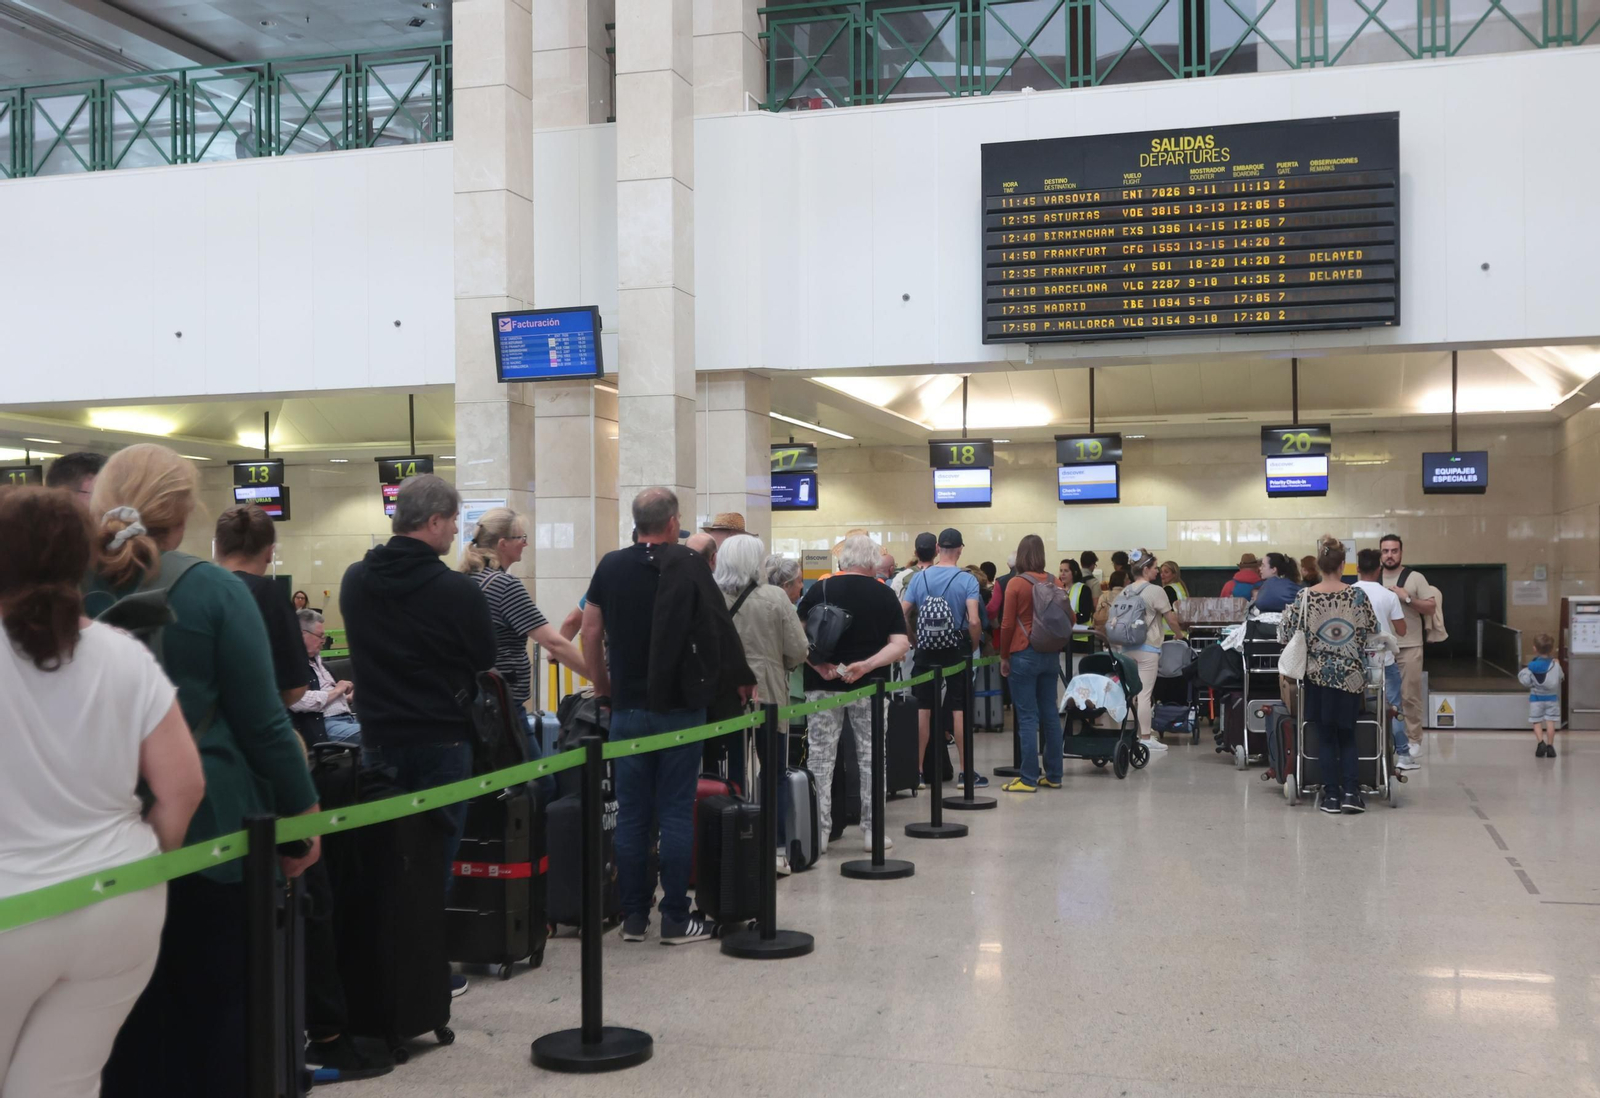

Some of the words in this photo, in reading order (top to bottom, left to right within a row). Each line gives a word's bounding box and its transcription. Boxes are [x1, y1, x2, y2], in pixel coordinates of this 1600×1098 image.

[1151, 135, 1215, 153] SALIDAS
[1139, 148, 1231, 167] DEPARTURES
[1276, 161, 1299, 169] PUERTA
[1309, 157, 1359, 167] OBSERVACIONES
[1123, 172, 1142, 180] VUELO
[1189, 166, 1226, 175] MOSTRADOR
[1232, 163, 1265, 172] EMBARQUE
[1232, 170, 1260, 178] BOARDING
[1309, 165, 1336, 173] REMARKS
[1044, 177, 1068, 186] DESTINO
[1122, 178, 1141, 186] FLIGHT
[1189, 173, 1215, 181] COUNTER
[1002, 197, 1036, 207] 11:45
[1044, 193, 1100, 204] VARSOVIA
[1123, 190, 1142, 200] ENT
[1152, 187, 1180, 198] 7026
[1189, 186, 1215, 196] 9-11
[1233, 181, 1270, 193] 11:13
[1278, 180, 1286, 190] 2
[1044, 182, 1077, 191] DESTINATION
[1002, 215, 1036, 225] 12:35
[1044, 211, 1099, 222] ASTURIAS
[1123, 208, 1143, 218] VOE
[1152, 206, 1180, 216] 3815
[1188, 203, 1224, 214] 13-13
[1233, 200, 1270, 211] 12:05
[1278, 199, 1286, 208] 5
[1002, 233, 1036, 243] 12:40
[1044, 229, 1114, 241] BIRMINGHAM
[1123, 226, 1143, 236] EXS
[1152, 224, 1180, 235] 1396
[1189, 221, 1224, 233] 14-15
[1233, 218, 1269, 230] 12:05
[1278, 217, 1286, 227] 7
[1002, 251, 1036, 261] 14:50
[1044, 247, 1106, 258] FRANKFURT
[1123, 245, 1143, 255] CFG
[1152, 243, 1180, 253] 1553
[1189, 240, 1224, 251] 13-15
[1233, 237, 1269, 248] 14:20
[1278, 237, 1286, 246] 2
[1002, 269, 1036, 279] 12:35
[1044, 265, 1106, 276] FRANKFURT
[1123, 263, 1135, 272] 4Y
[1152, 262, 1171, 271] 501
[1189, 258, 1224, 269] 18-20
[1234, 256, 1270, 267] 14:20
[1278, 255, 1286, 265] 2
[1310, 250, 1362, 263] DELAYED
[1002, 287, 1036, 296] 14:10
[1045, 283, 1107, 295] BARCELONA
[1123, 281, 1143, 291] VLG
[1152, 279, 1180, 290] 2287
[1189, 277, 1217, 288] 9-10
[1233, 275, 1270, 286] 14:35
[1278, 274, 1286, 283] 2
[1310, 270, 1362, 282] DELAYED
[1002, 305, 1036, 314] 17:35
[1044, 302, 1085, 312] MADRID
[1124, 300, 1143, 309] IBE
[1152, 298, 1180, 308] 1094
[1189, 297, 1210, 306] 5-6
[1233, 293, 1270, 304] 17:05
[1278, 292, 1286, 301] 7
[512, 318, 560, 329] Facturación
[1002, 323, 1036, 332] 17:50
[1044, 319, 1114, 330] P.MALLORCA
[1123, 318, 1143, 327] VLG
[1152, 316, 1180, 326] 3154
[1189, 315, 1217, 325] 9-10
[1234, 312, 1270, 323] 17:20
[1278, 310, 1286, 321] 2
[1075, 440, 1103, 461] 19
[1281, 432, 1312, 453] 20
[775, 450, 800, 469] 17
[948, 445, 976, 465] 18
[9, 472, 26, 486] 11
[248, 466, 269, 483] 13
[394, 462, 417, 480] 14
[1433, 475, 1478, 483] ESPECIALES
[1435, 467, 1475, 475] EQUIPAJES
